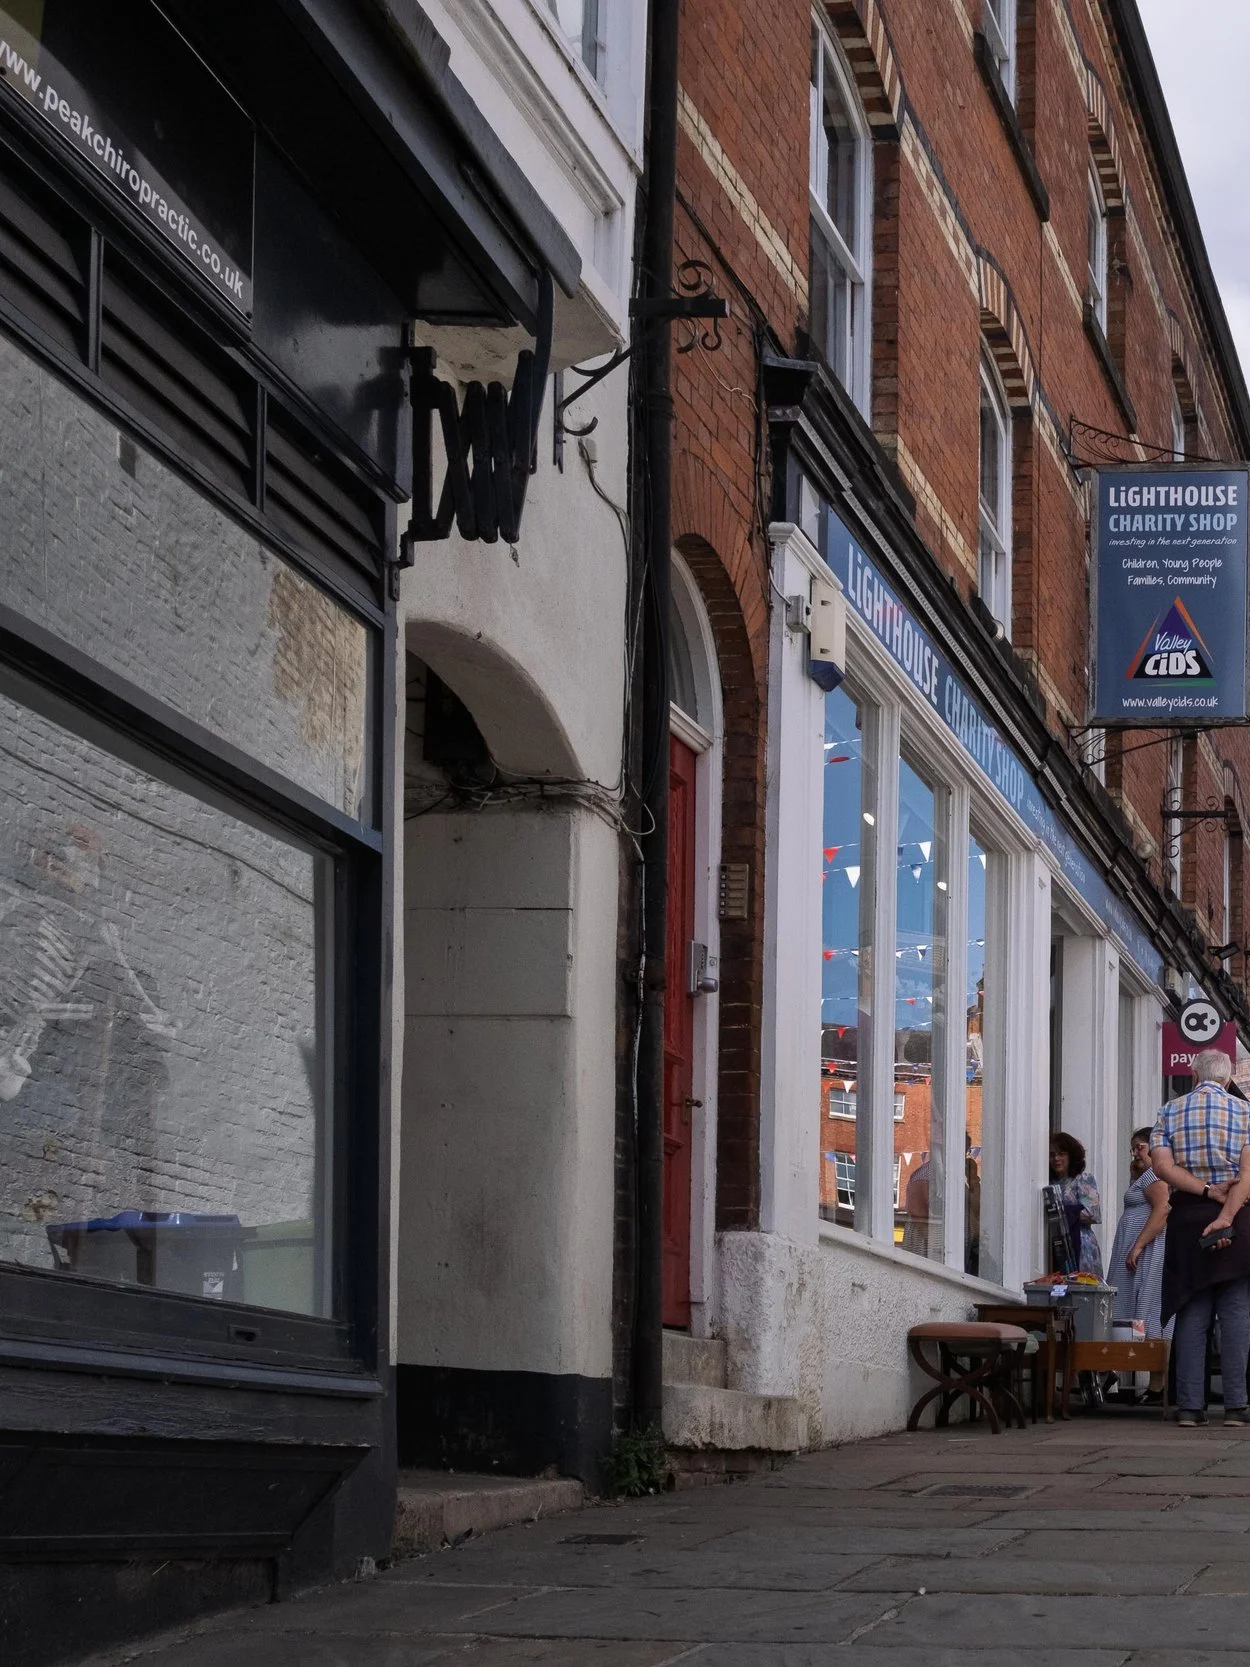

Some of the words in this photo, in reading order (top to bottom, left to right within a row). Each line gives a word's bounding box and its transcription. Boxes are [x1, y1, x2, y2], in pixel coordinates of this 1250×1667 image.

[1109, 514, 1185, 532] CHARITY
[1189, 513, 1238, 531] SHOP
[1109, 537, 1146, 548] investing
[1148, 538, 1155, 546] in
[1156, 537, 1170, 546] the
[1172, 536, 1191, 545] next
[1190, 536, 1238, 548] generation
[1122, 558, 1159, 569] Children,
[1162, 559, 1188, 572] Young
[1192, 558, 1223, 572] People
[1127, 575, 1165, 586] Families,
[1167, 575, 1217, 588] Community
[1155, 631, 1192, 654] Valley
[1122, 696, 1219, 712] www.valleycids.co.uk
[944, 675, 998, 775] CHARITY
[996, 741, 1024, 812] SHOP
